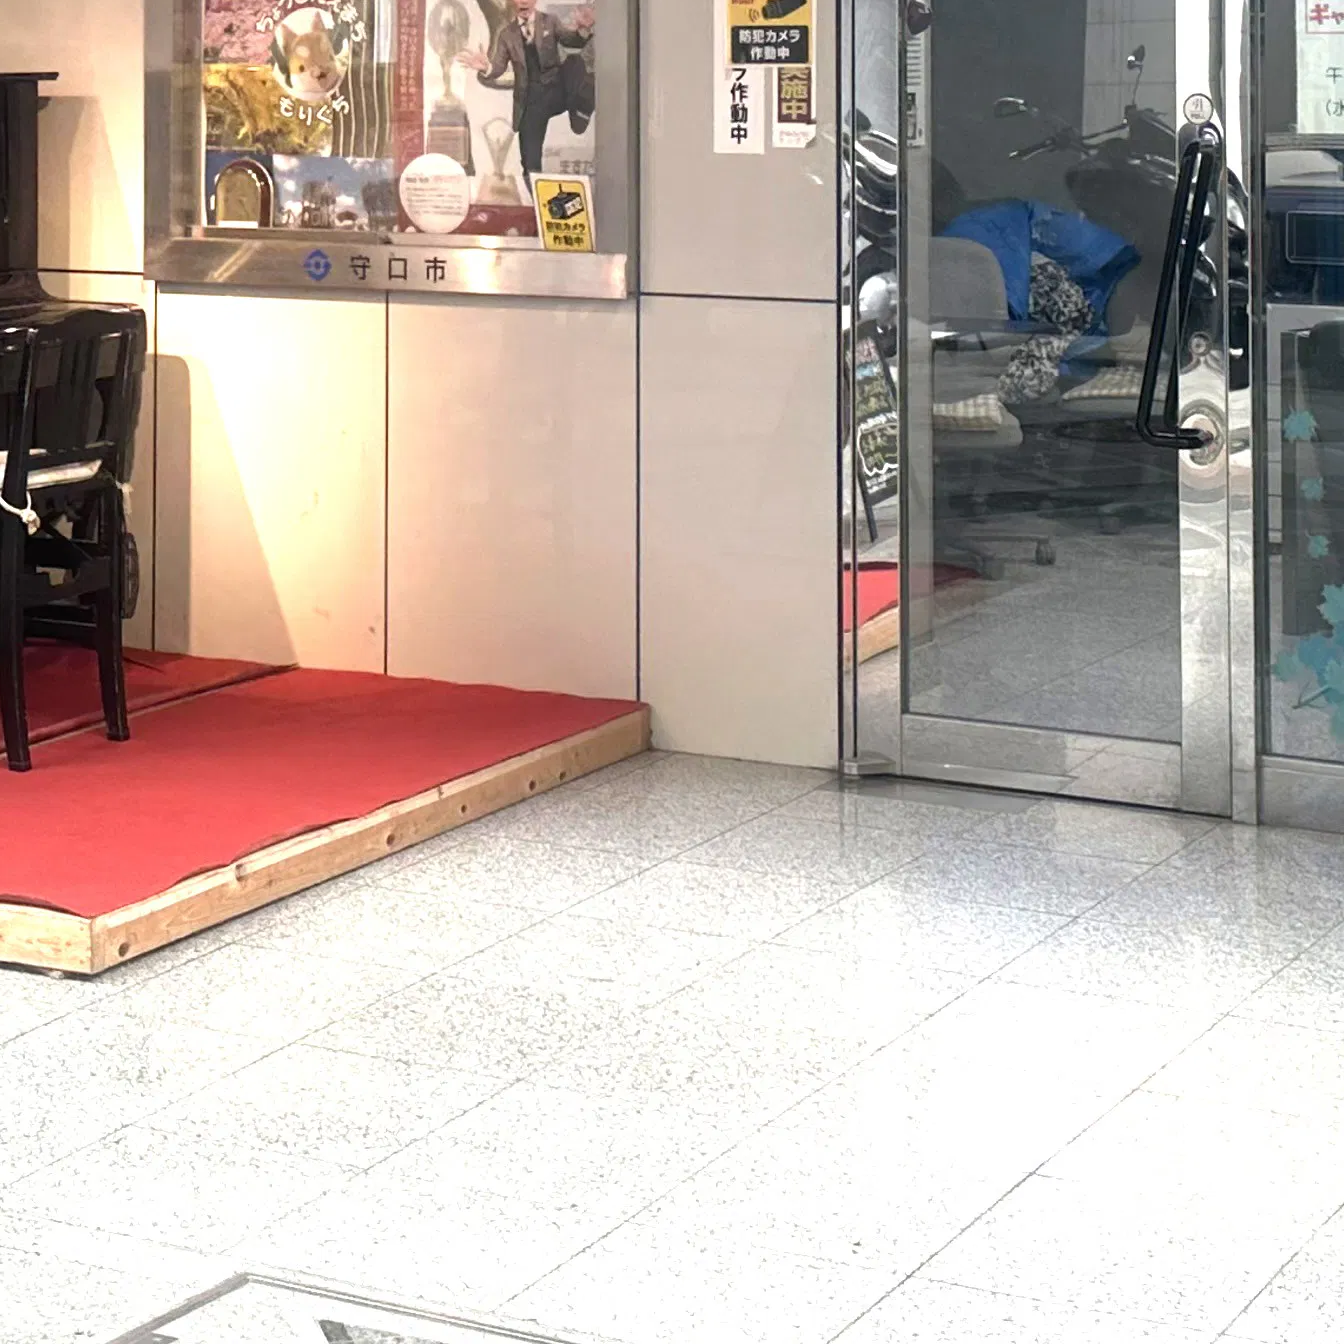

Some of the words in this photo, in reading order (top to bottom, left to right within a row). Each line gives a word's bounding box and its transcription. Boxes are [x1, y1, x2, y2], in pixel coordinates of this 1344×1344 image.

[739, 29, 801, 44] 防犯カメラ
[750, 45, 791, 61] 作動中
[279, 95, 350, 126] もりぐち
[349, 255, 449, 284] 守口市
